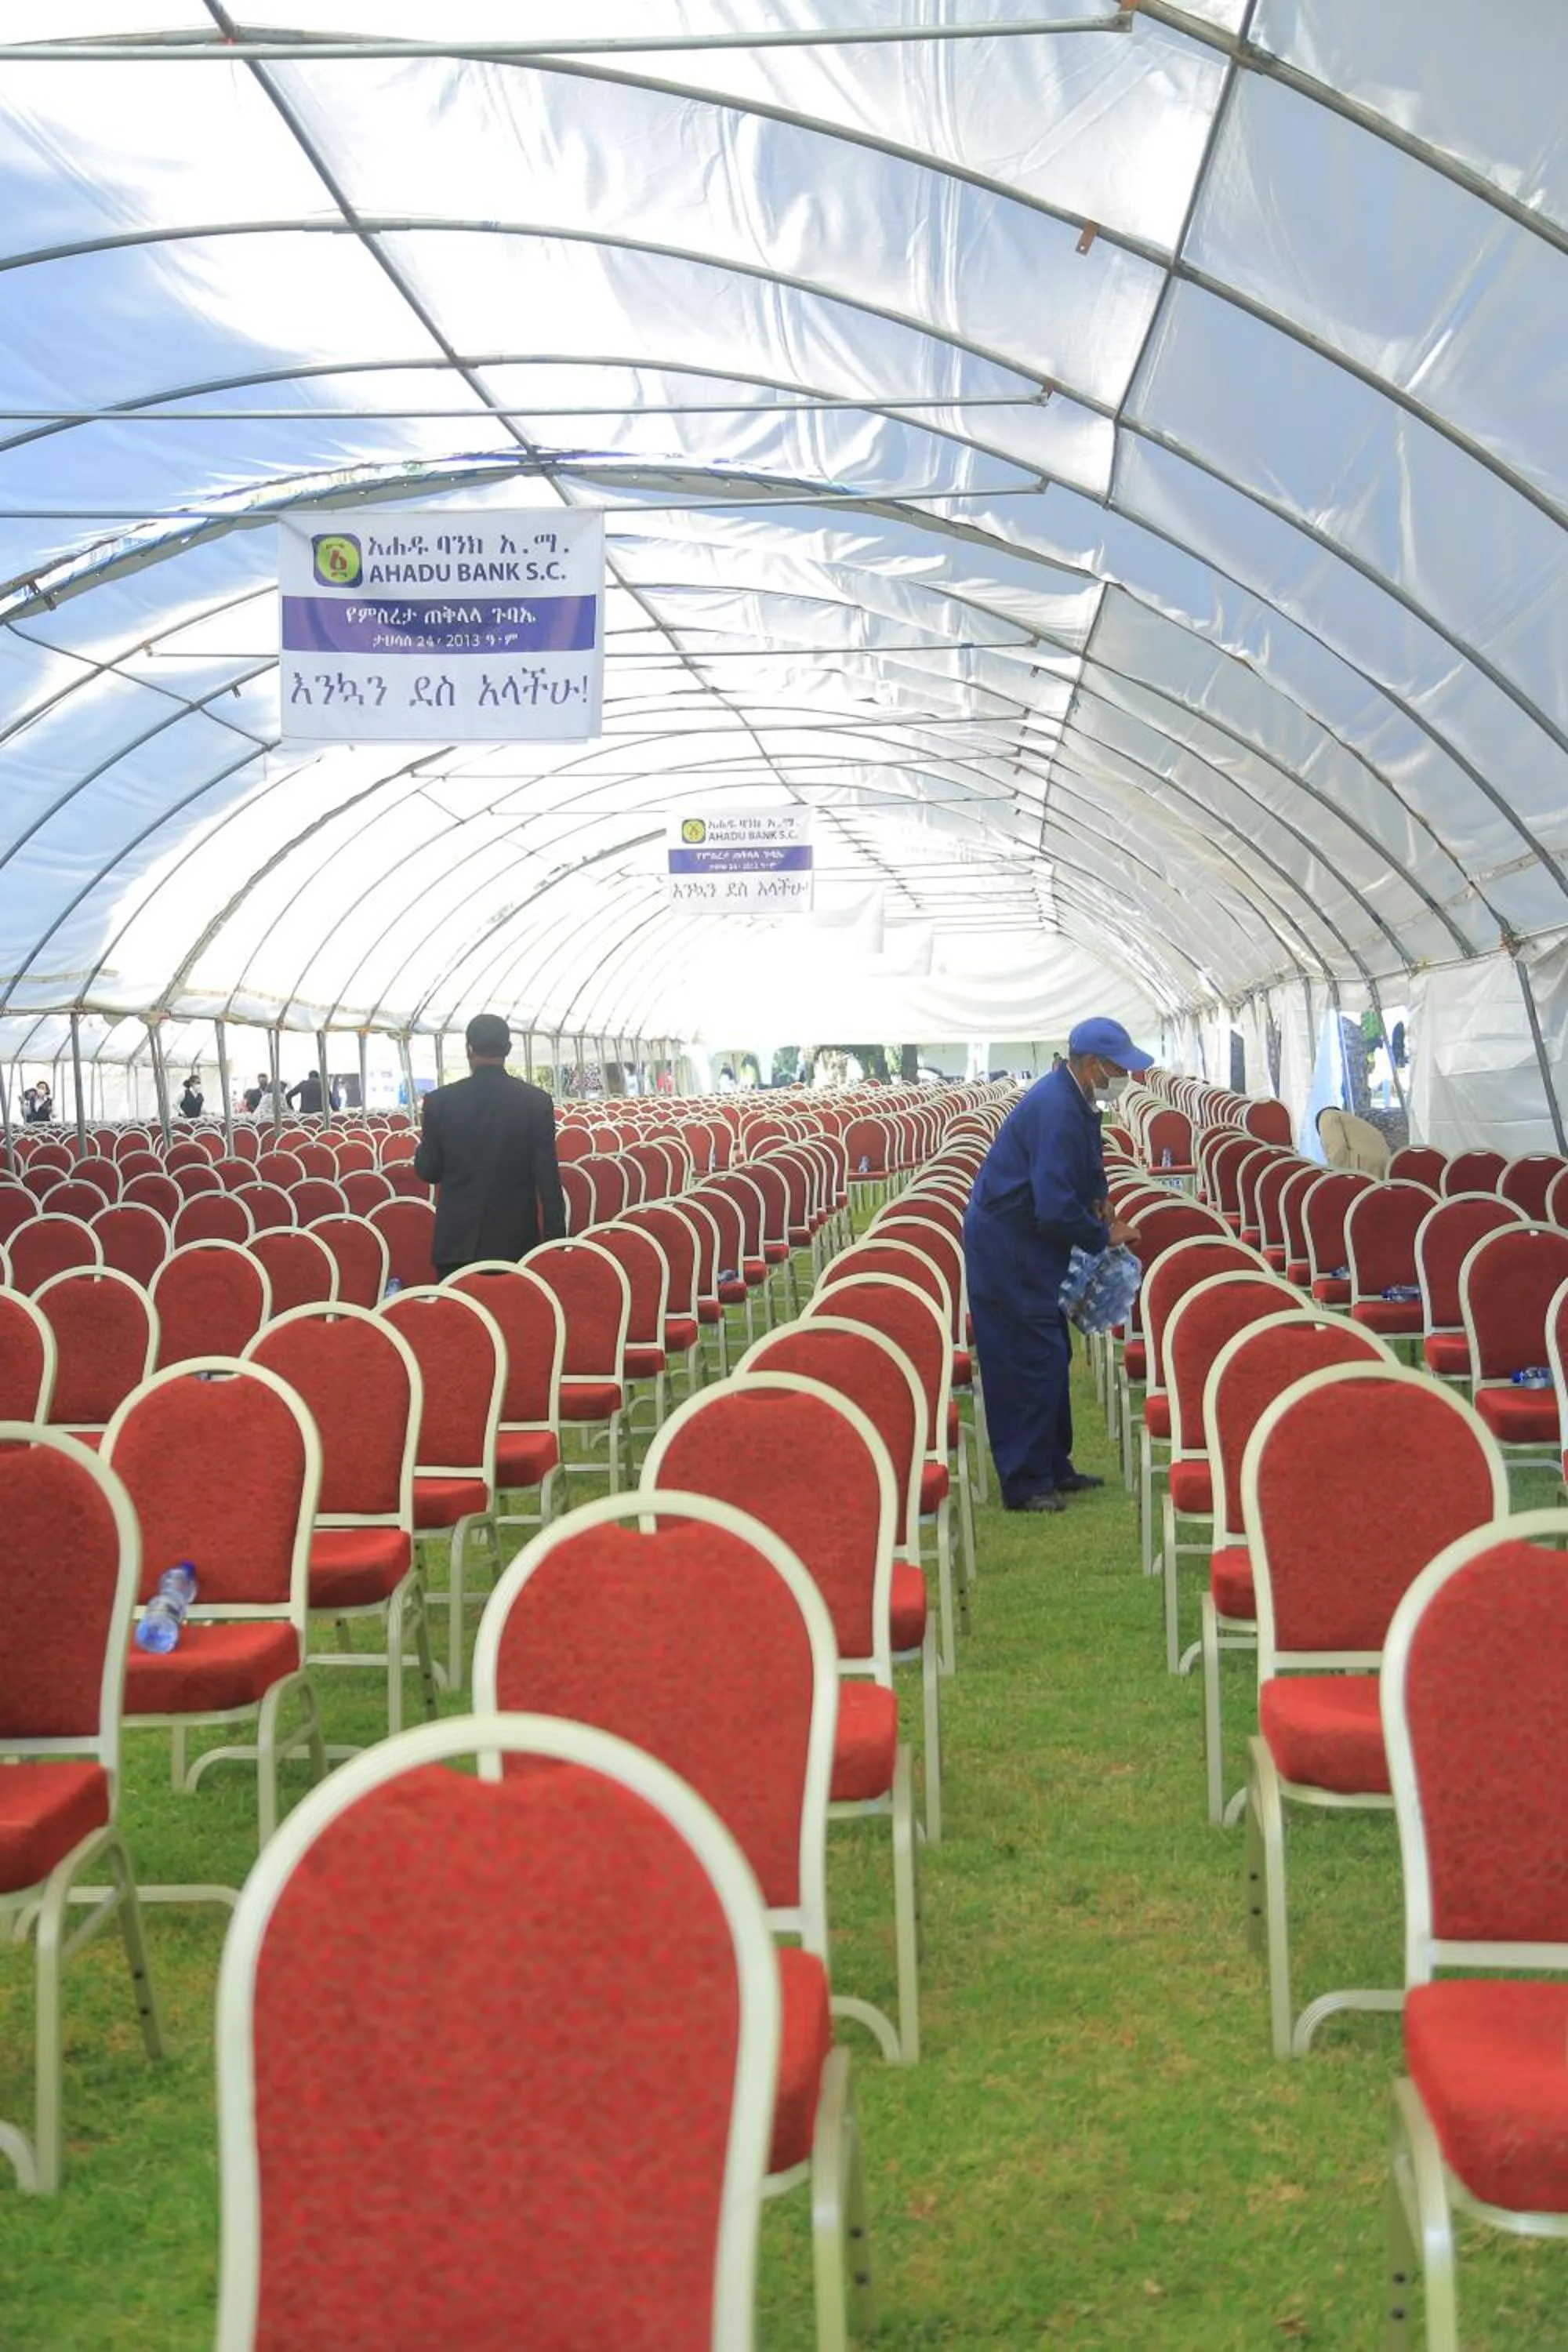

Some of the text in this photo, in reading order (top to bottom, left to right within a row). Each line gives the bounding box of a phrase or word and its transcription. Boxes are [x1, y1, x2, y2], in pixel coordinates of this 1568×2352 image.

[437, 535, 483, 554] ባንክ
[369, 561, 566, 583] AHADU BANK S.C.
[446, 633, 481, 648] 2013
[291, 672, 388, 706] እንኳን
[409, 674, 456, 706] ደስ
[708, 829, 798, 841] AHADU BANK S.C.
